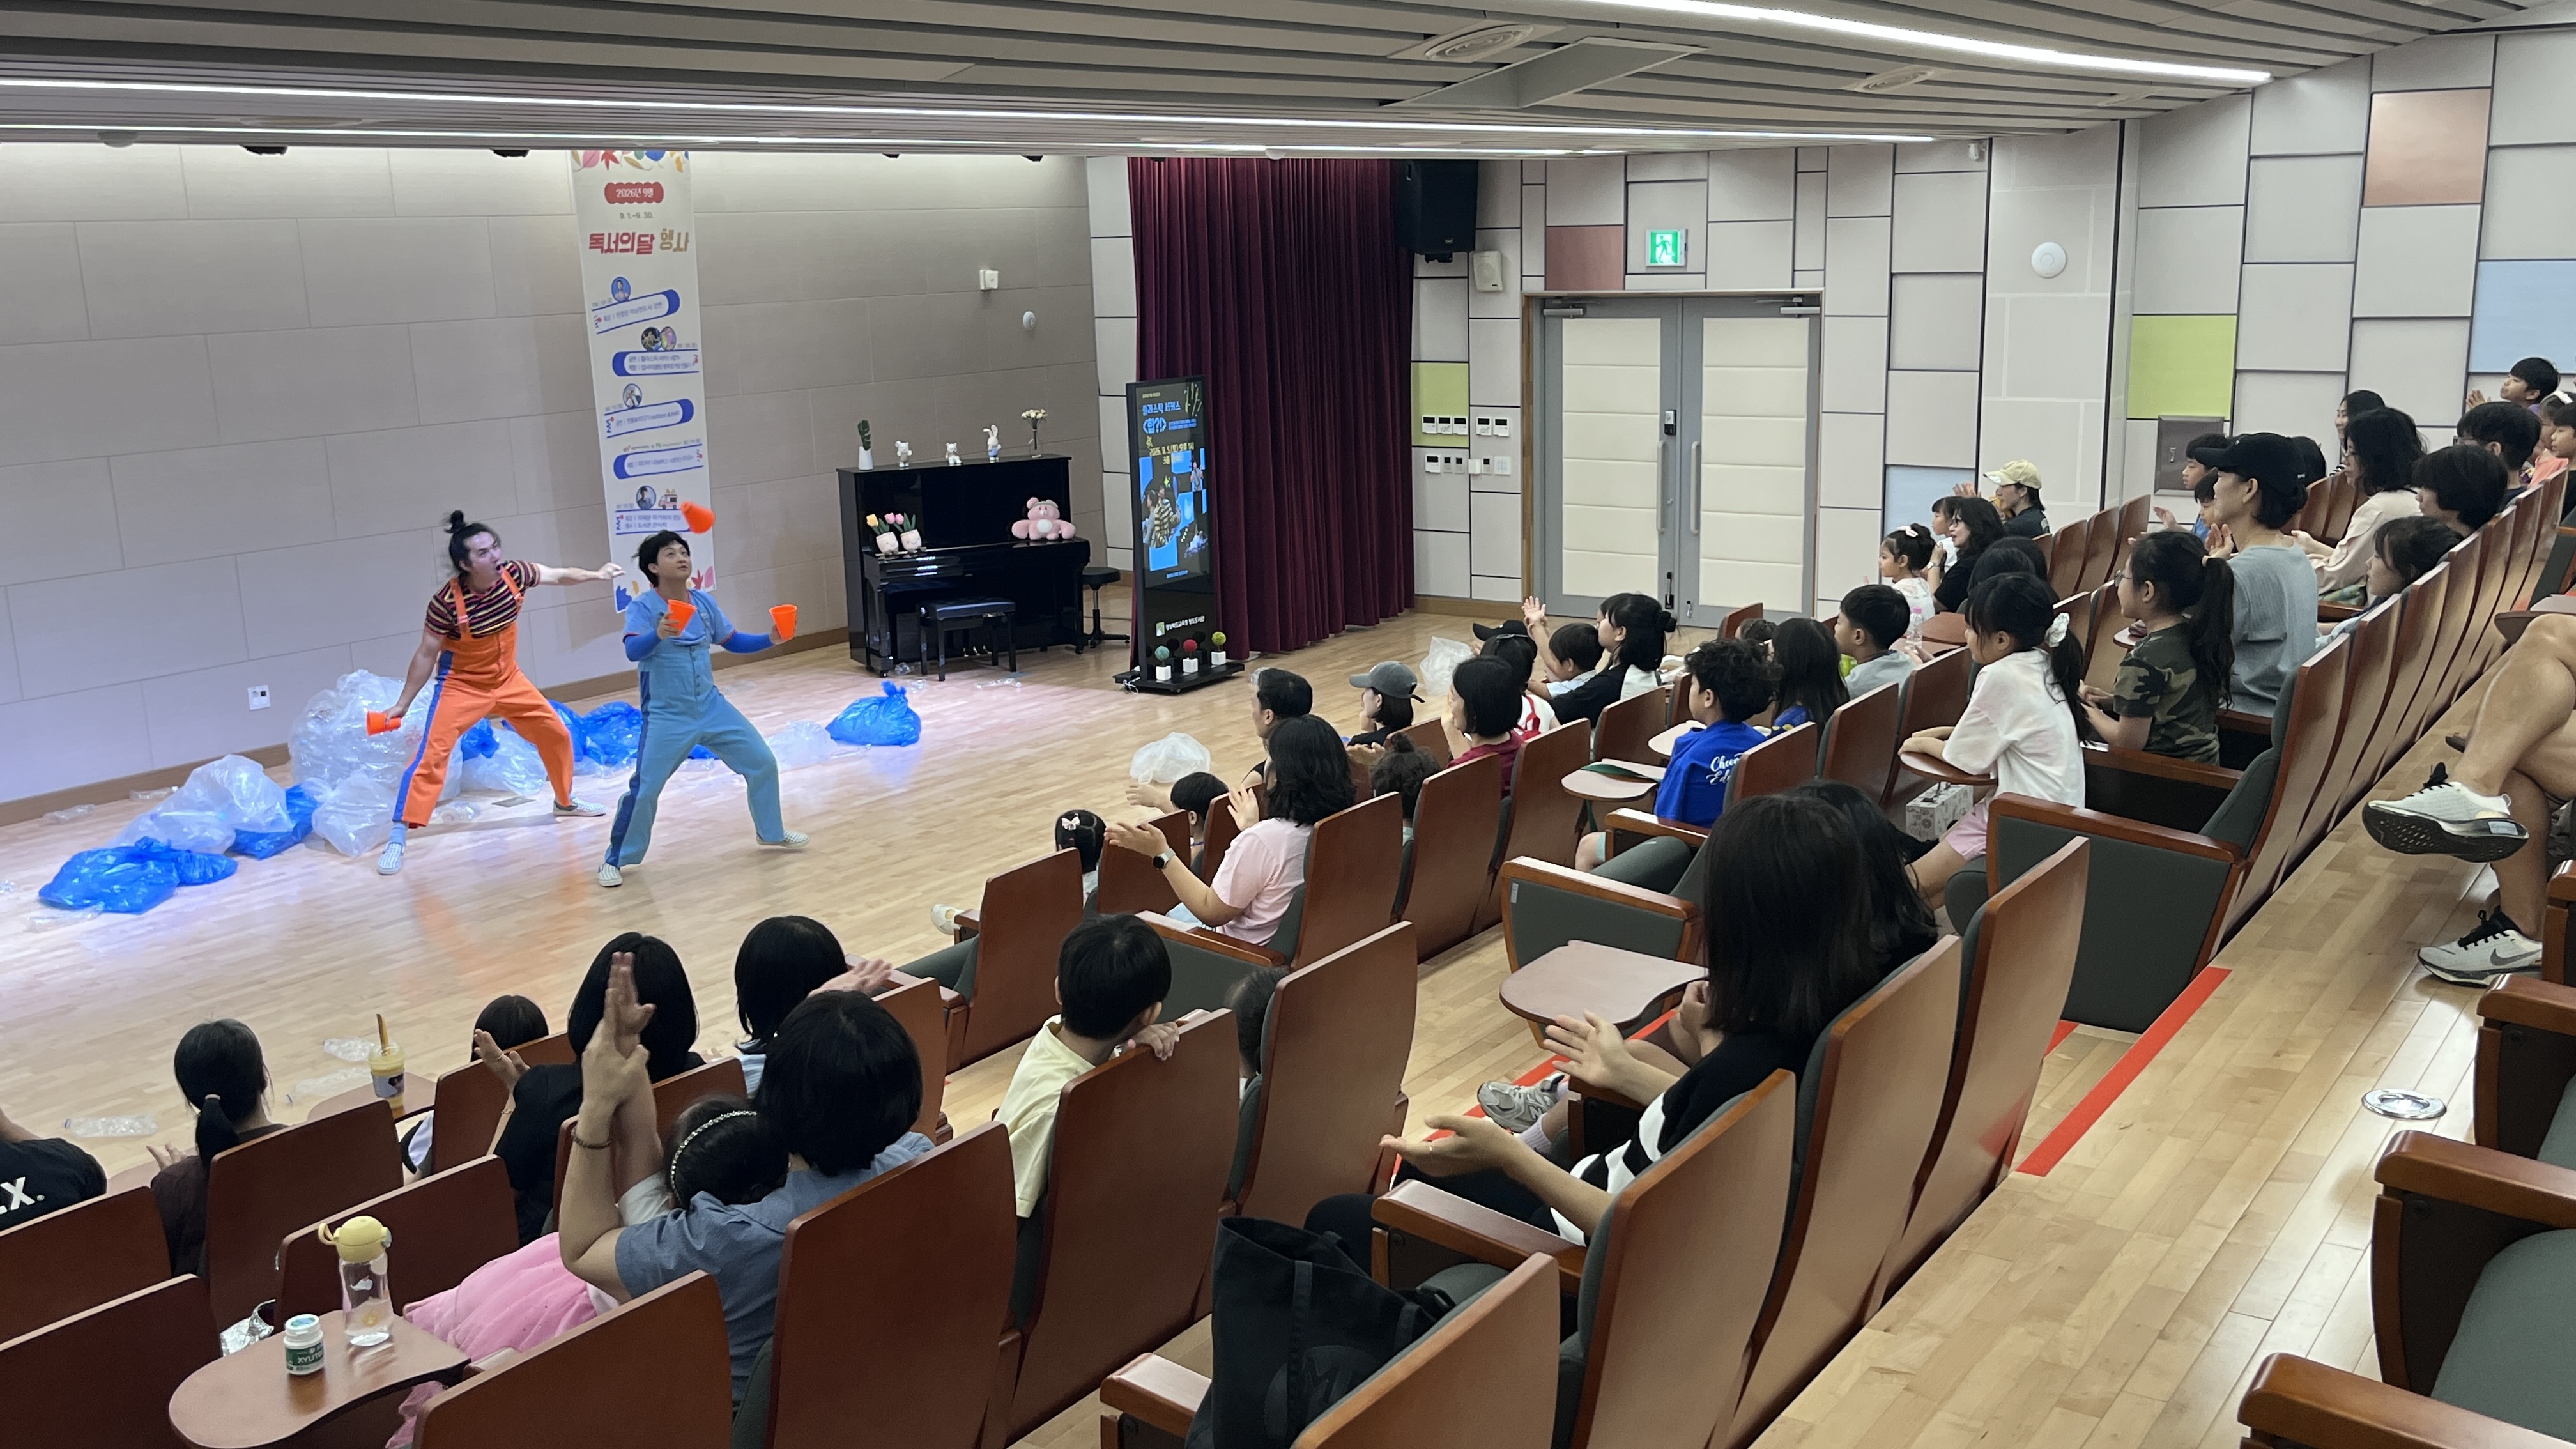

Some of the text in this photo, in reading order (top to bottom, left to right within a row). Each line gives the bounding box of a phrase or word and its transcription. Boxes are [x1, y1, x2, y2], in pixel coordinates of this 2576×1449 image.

[615, 188, 641, 198] 2026년
[588, 228, 690, 254] 독서의달 행사
[1165, 401, 1181, 412] 서커스
[0, 1176, 45, 1215] X.
